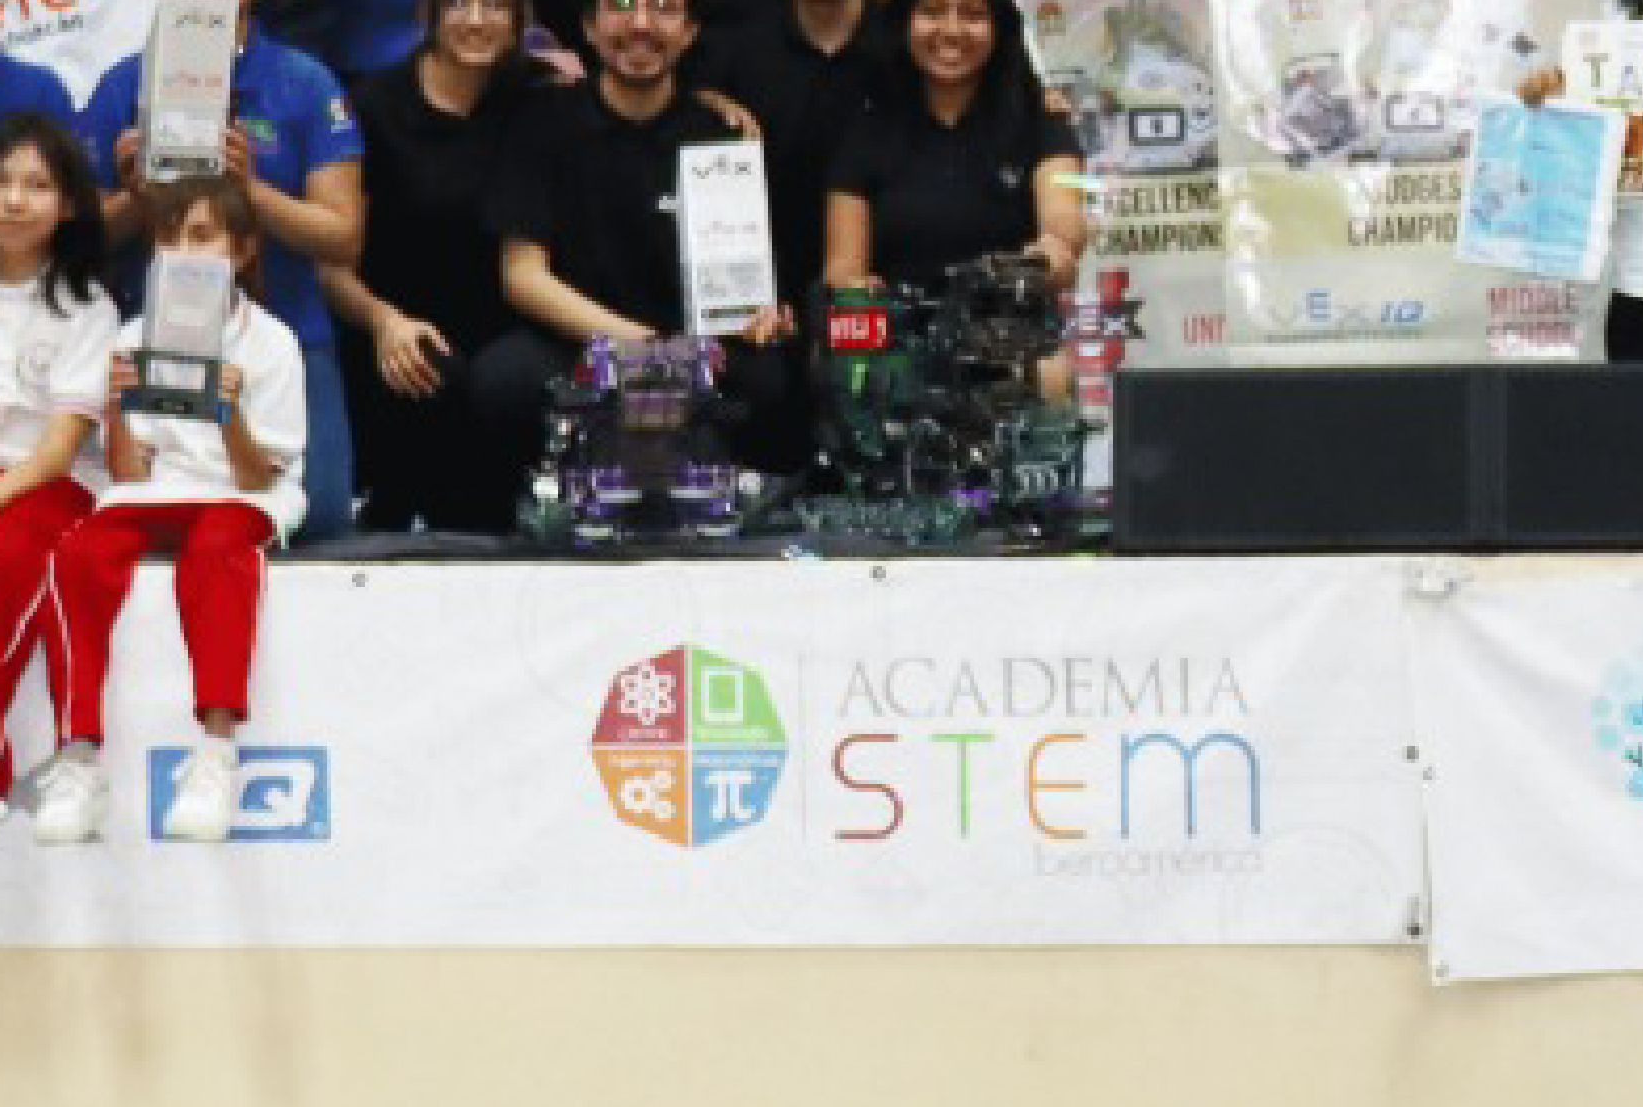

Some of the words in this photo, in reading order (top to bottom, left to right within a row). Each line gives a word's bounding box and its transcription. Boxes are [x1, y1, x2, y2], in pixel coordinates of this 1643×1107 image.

[1094, 221, 1225, 256] CHAMPION
[1345, 206, 1460, 245] CHAMPIO
[837, 654, 1252, 719] ACADEMIA
